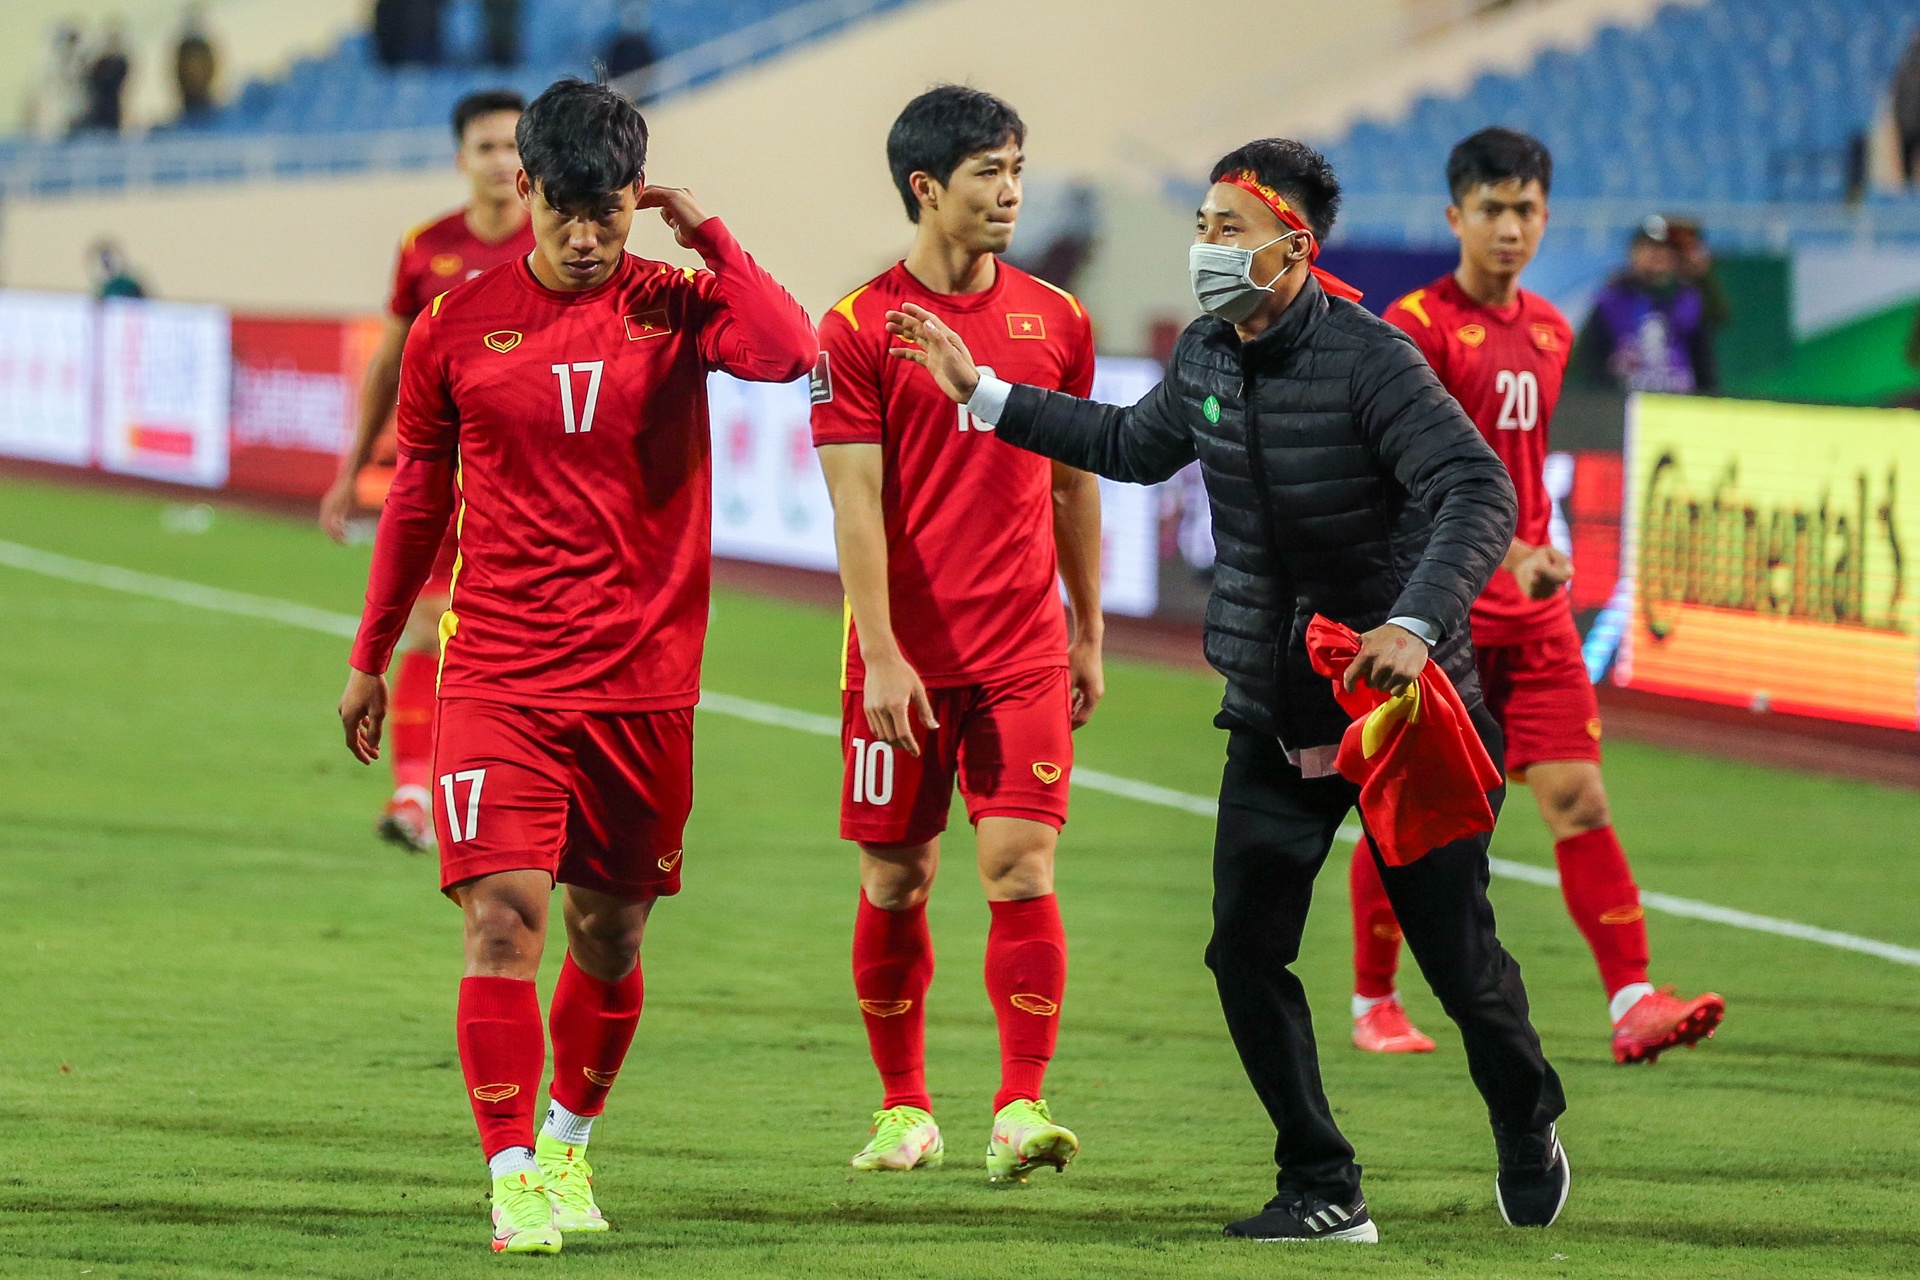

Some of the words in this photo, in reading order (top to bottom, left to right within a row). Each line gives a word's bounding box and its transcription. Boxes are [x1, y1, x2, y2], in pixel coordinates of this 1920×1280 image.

[551, 360, 604, 434] 17
[1495, 369, 1539, 432] 20
[439, 768, 487, 844] 17
[852, 737, 894, 806] 10
